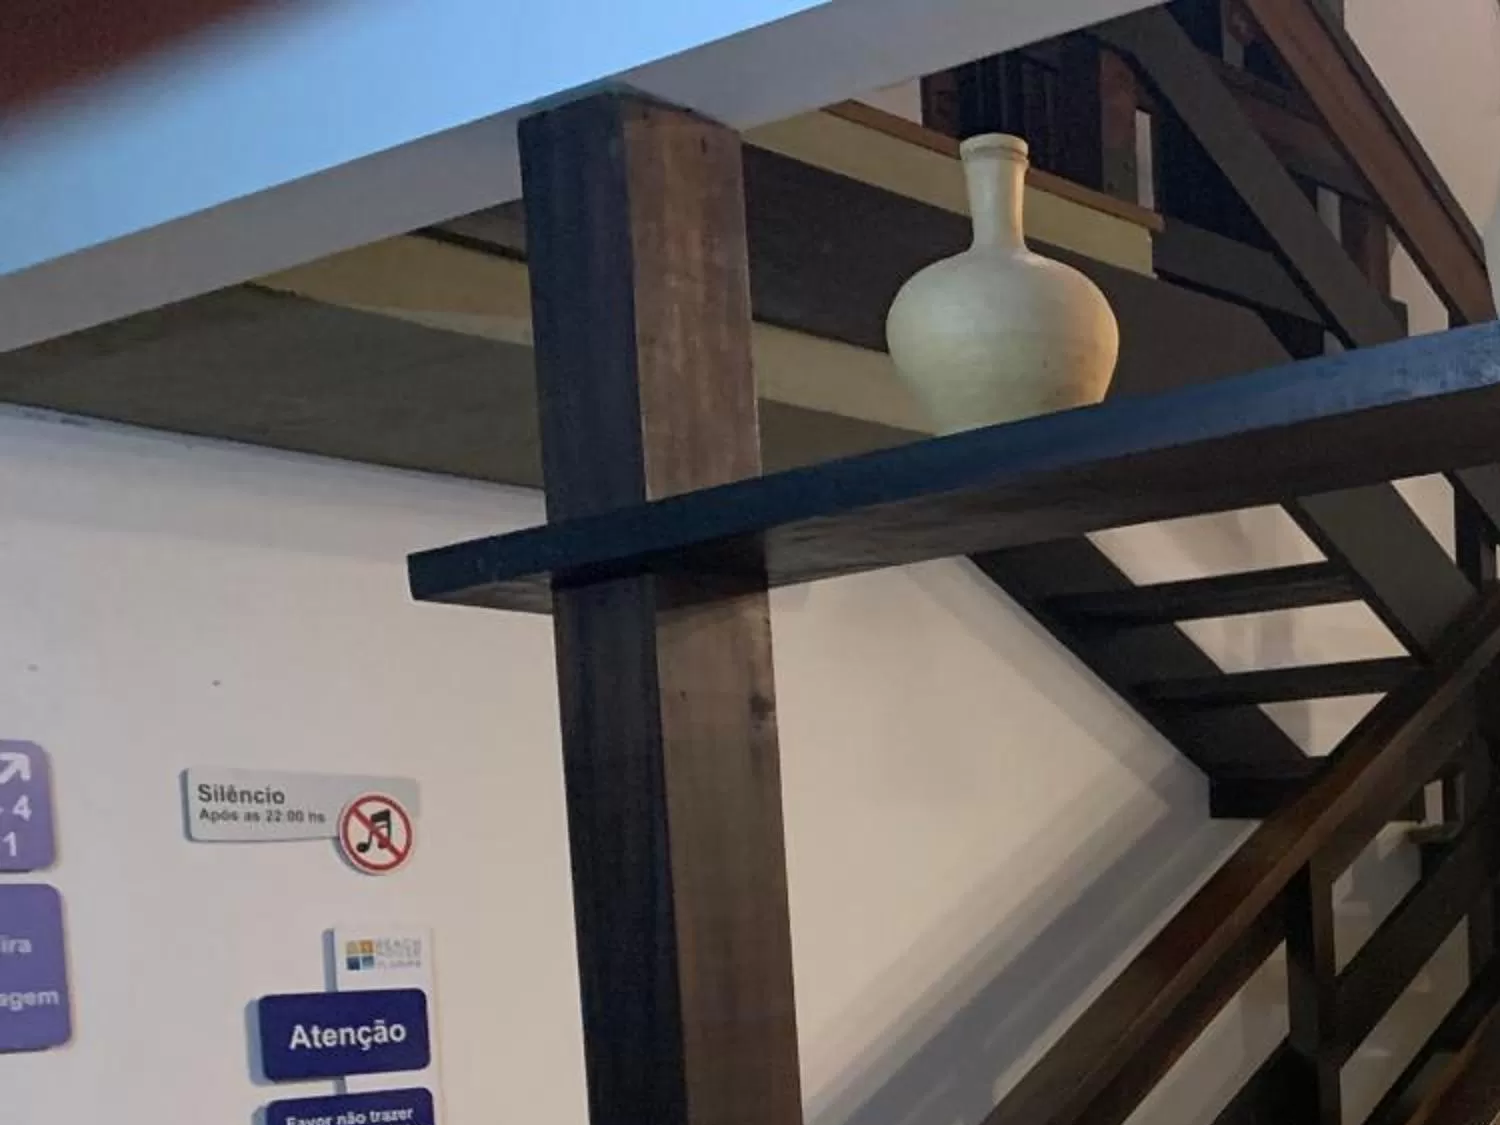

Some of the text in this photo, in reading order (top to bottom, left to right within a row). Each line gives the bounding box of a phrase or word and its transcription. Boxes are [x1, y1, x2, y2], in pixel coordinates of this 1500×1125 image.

[197, 783, 286, 805] Silêncio
[12, 794, 33, 821] 4
[199, 807, 239, 824] Após
[289, 1019, 407, 1051] Atenção
[336, 1111, 366, 1125] não
[369, 1107, 413, 1122] trazer
